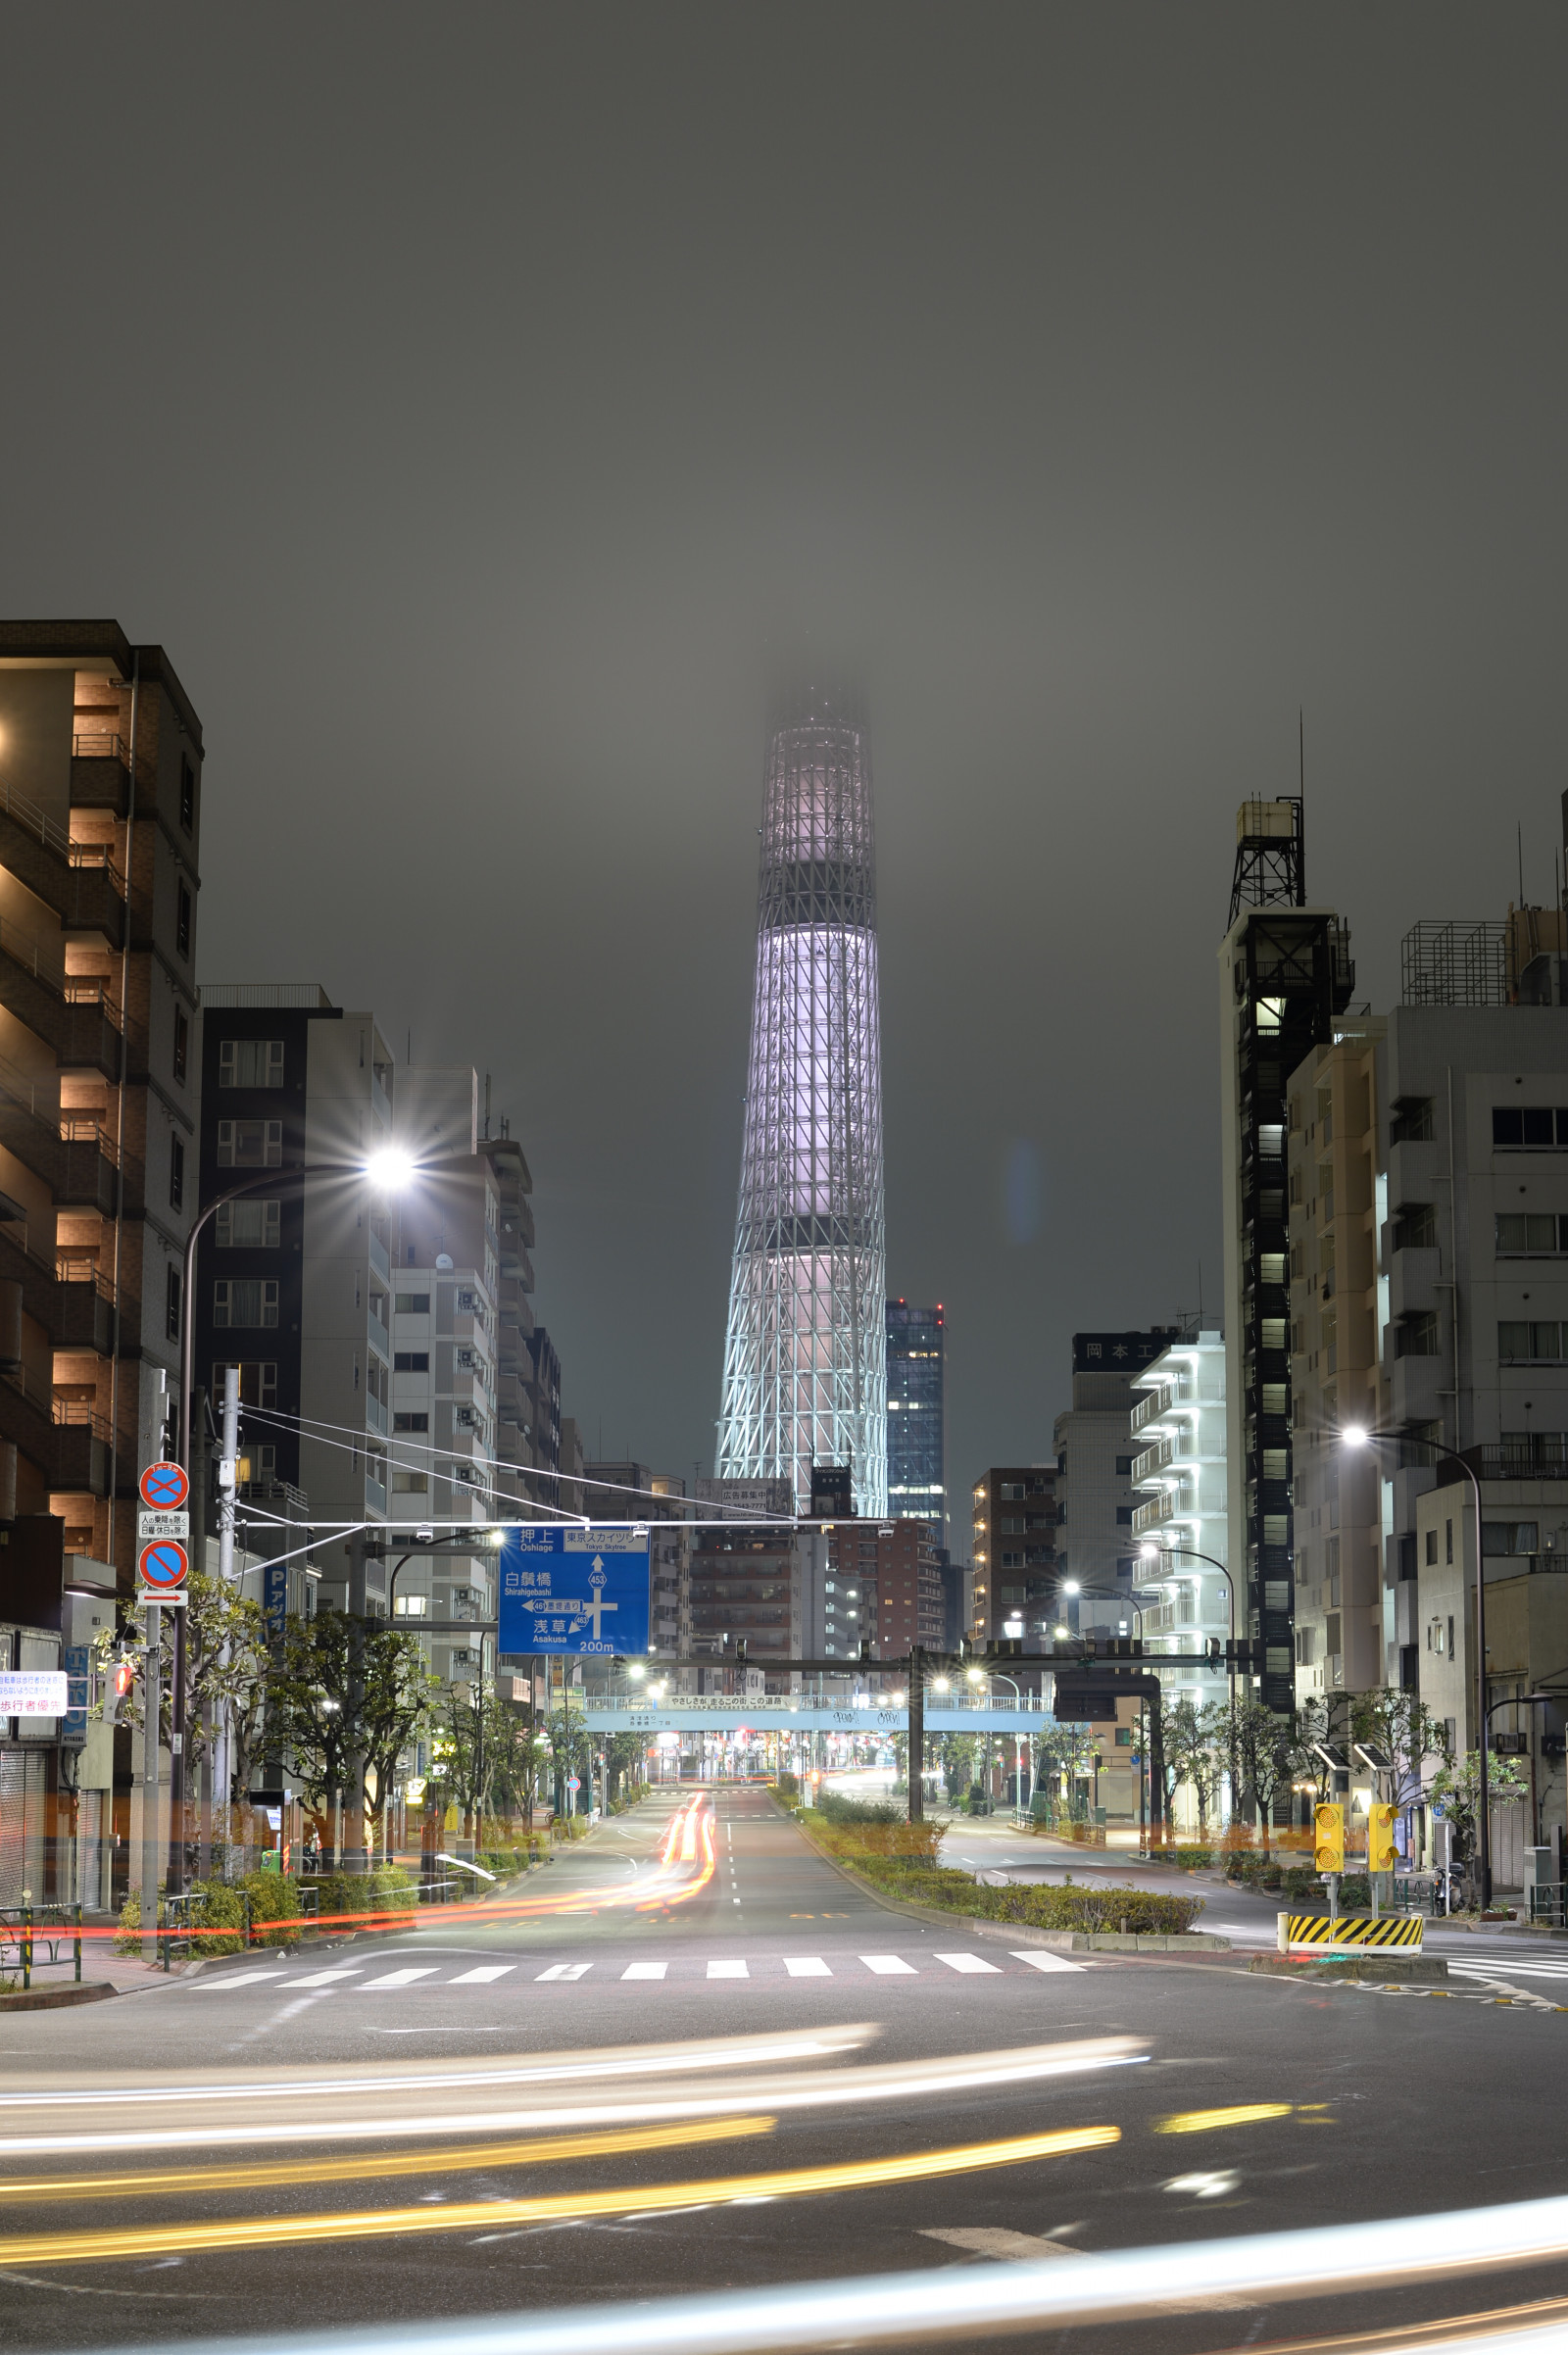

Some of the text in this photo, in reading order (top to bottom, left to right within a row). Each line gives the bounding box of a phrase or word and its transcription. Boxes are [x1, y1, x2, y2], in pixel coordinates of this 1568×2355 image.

[1087, 1343, 1171, 1360] 岡本工
[722, 1491, 766, 1499] 広告募集中
[141, 1515, 186, 1524] 人の乗降を除く
[520, 1529, 554, 1544] 押上
[566, 1532, 638, 1544] 東京スカイツリ
[520, 1544, 554, 1553] Oshiage
[590, 1575, 605, 1585] 453
[504, 1588, 552, 1597] Shirahigebashi
[548, 1601, 579, 1610] 墨堤通り
[533, 1619, 566, 1635] 浅草
[532, 1635, 567, 1644] Asakusa
[579, 1641, 613, 1652] 200m
[66, 1649, 86, 1725] TOTO
[0, 1699, 62, 1712] 歩行者優先
[671, 1696, 782, 1706] やさしさが 走るこの街 この道路
